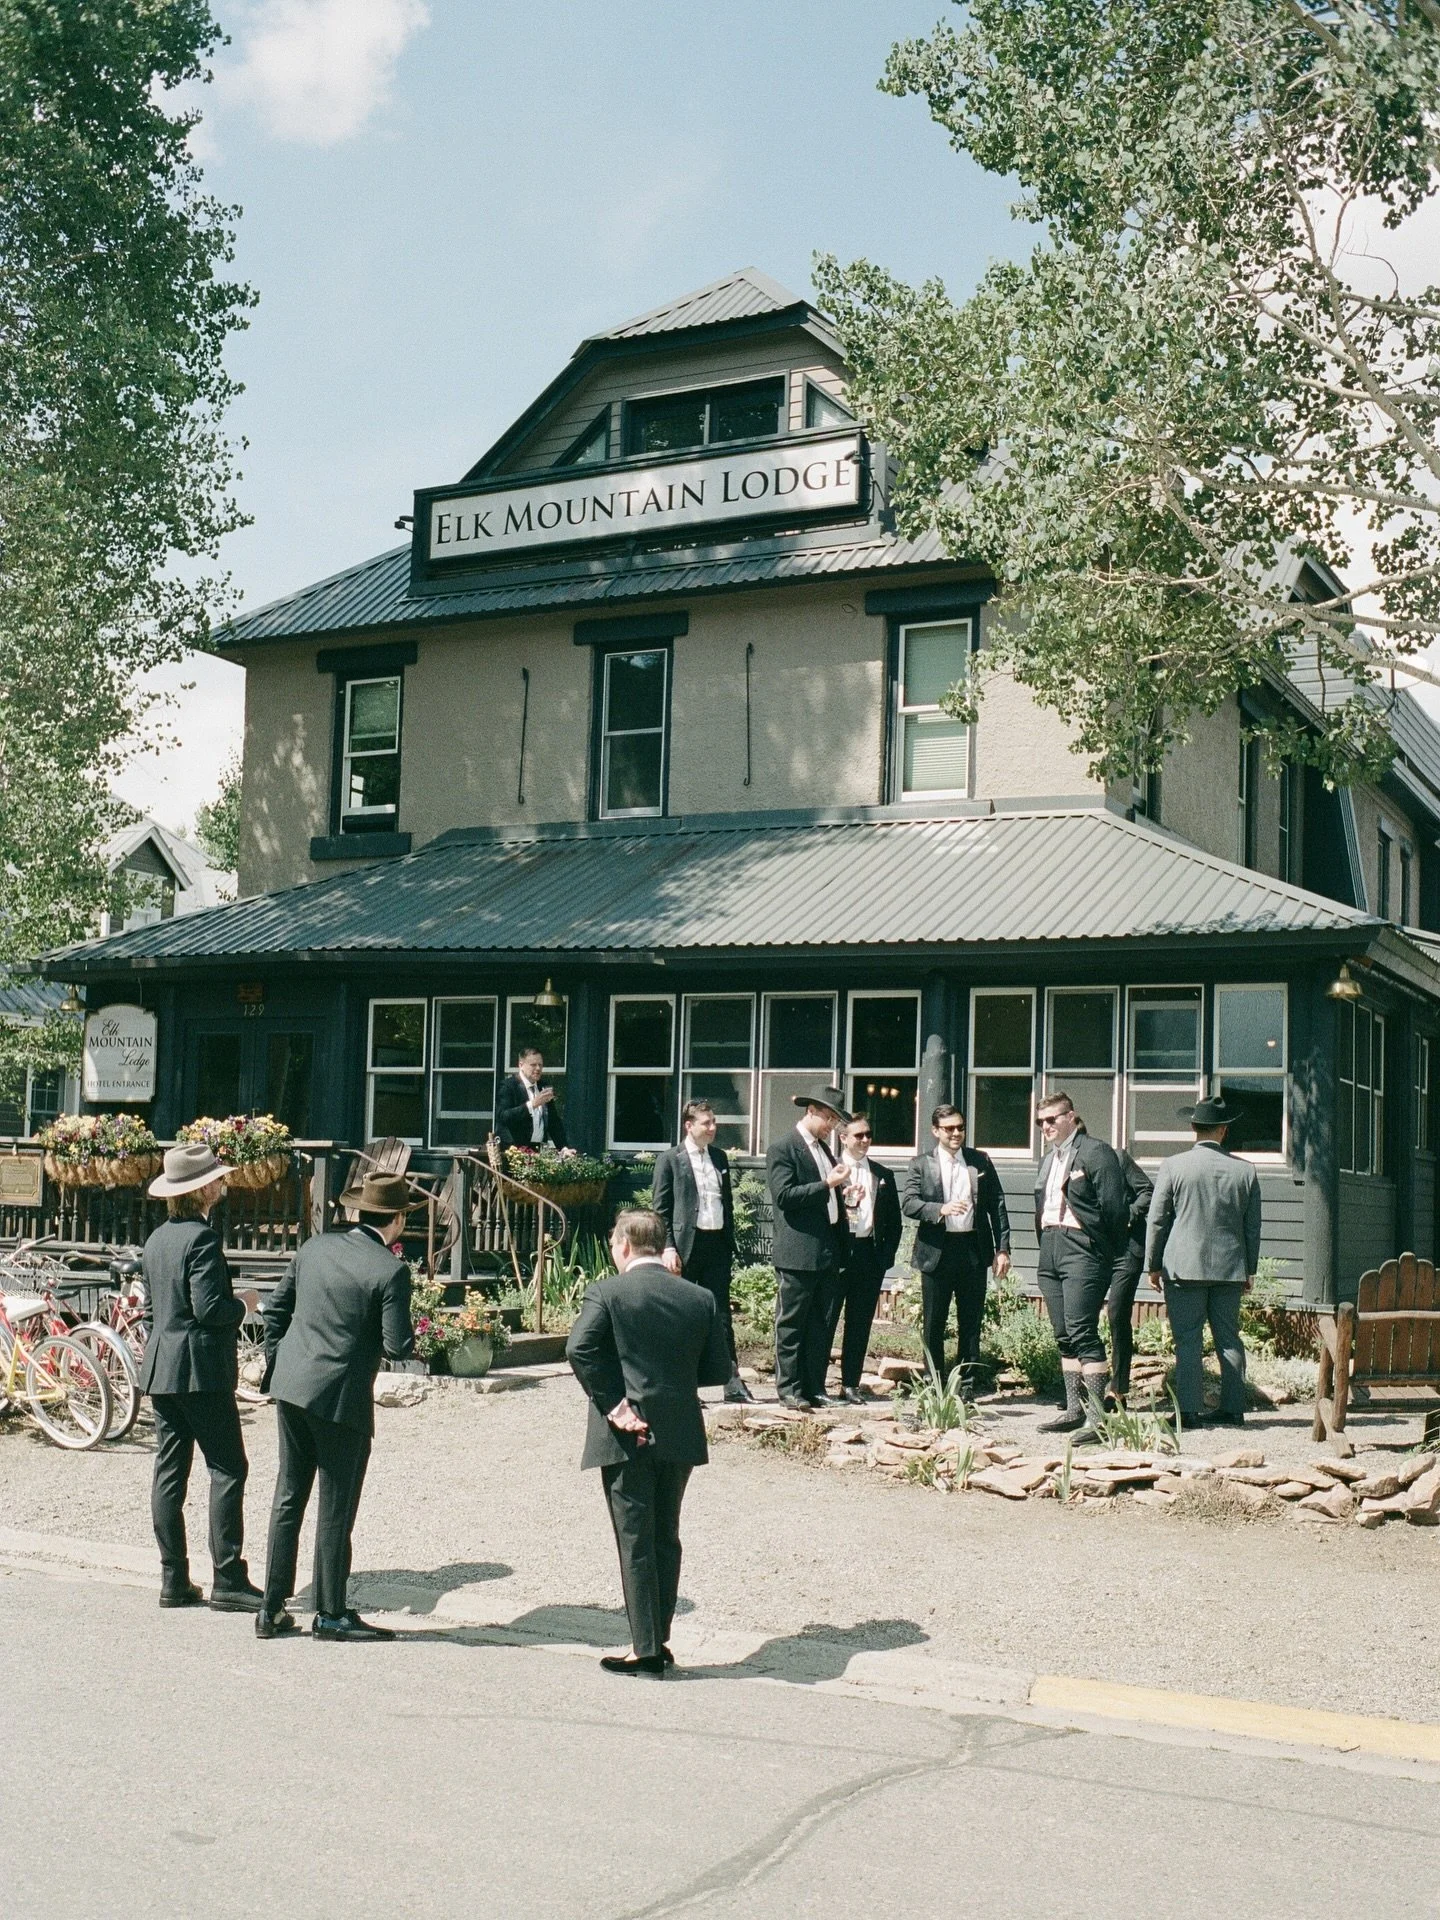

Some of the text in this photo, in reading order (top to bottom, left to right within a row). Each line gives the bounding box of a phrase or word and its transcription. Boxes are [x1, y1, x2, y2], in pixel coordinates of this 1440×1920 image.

[436, 458, 850, 545] ELK MOUNTAIN LODGE
[243, 1003, 265, 1017] 129
[101, 1019, 120, 1036] Elk
[88, 1036, 153, 1048] MOUNTAIN
[118, 1048, 150, 1072] Lodge
[87, 1080, 150, 1088] HOTEL ENTRANCE
